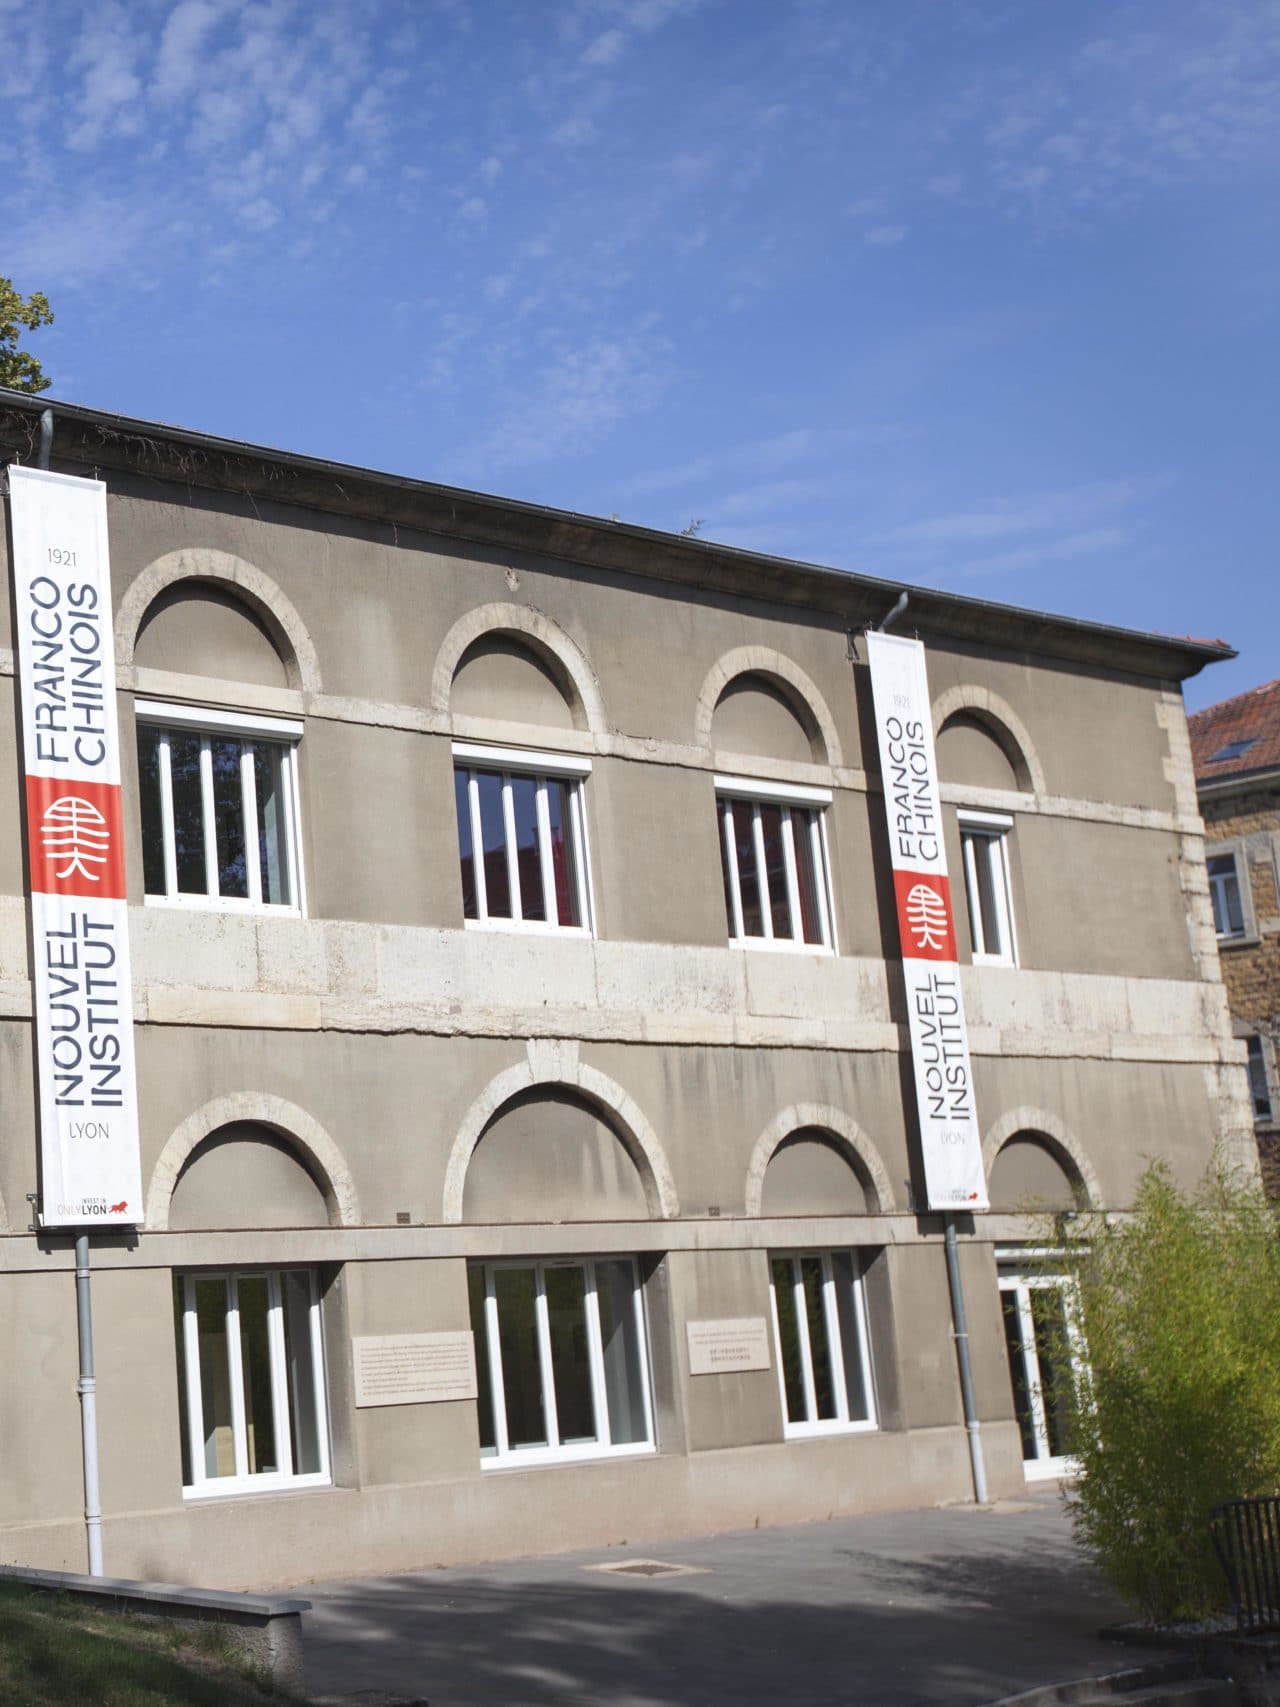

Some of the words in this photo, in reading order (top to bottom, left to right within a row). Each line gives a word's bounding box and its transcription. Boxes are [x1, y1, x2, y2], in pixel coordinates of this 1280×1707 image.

[47, 548, 77, 567] 1921
[29, 576, 69, 763] FRANCO
[67, 583, 106, 766] CHINOIS
[886, 716, 917, 859] FRANCO
[906, 721, 939, 861] CHINOIS
[45, 912, 85, 1107] NOUVEL
[82, 913, 123, 1107] INSTITUT
[915, 973, 947, 1120] NOUVEL
[933, 974, 970, 1121] INSTITUT
[69, 1122, 110, 1139] LYON
